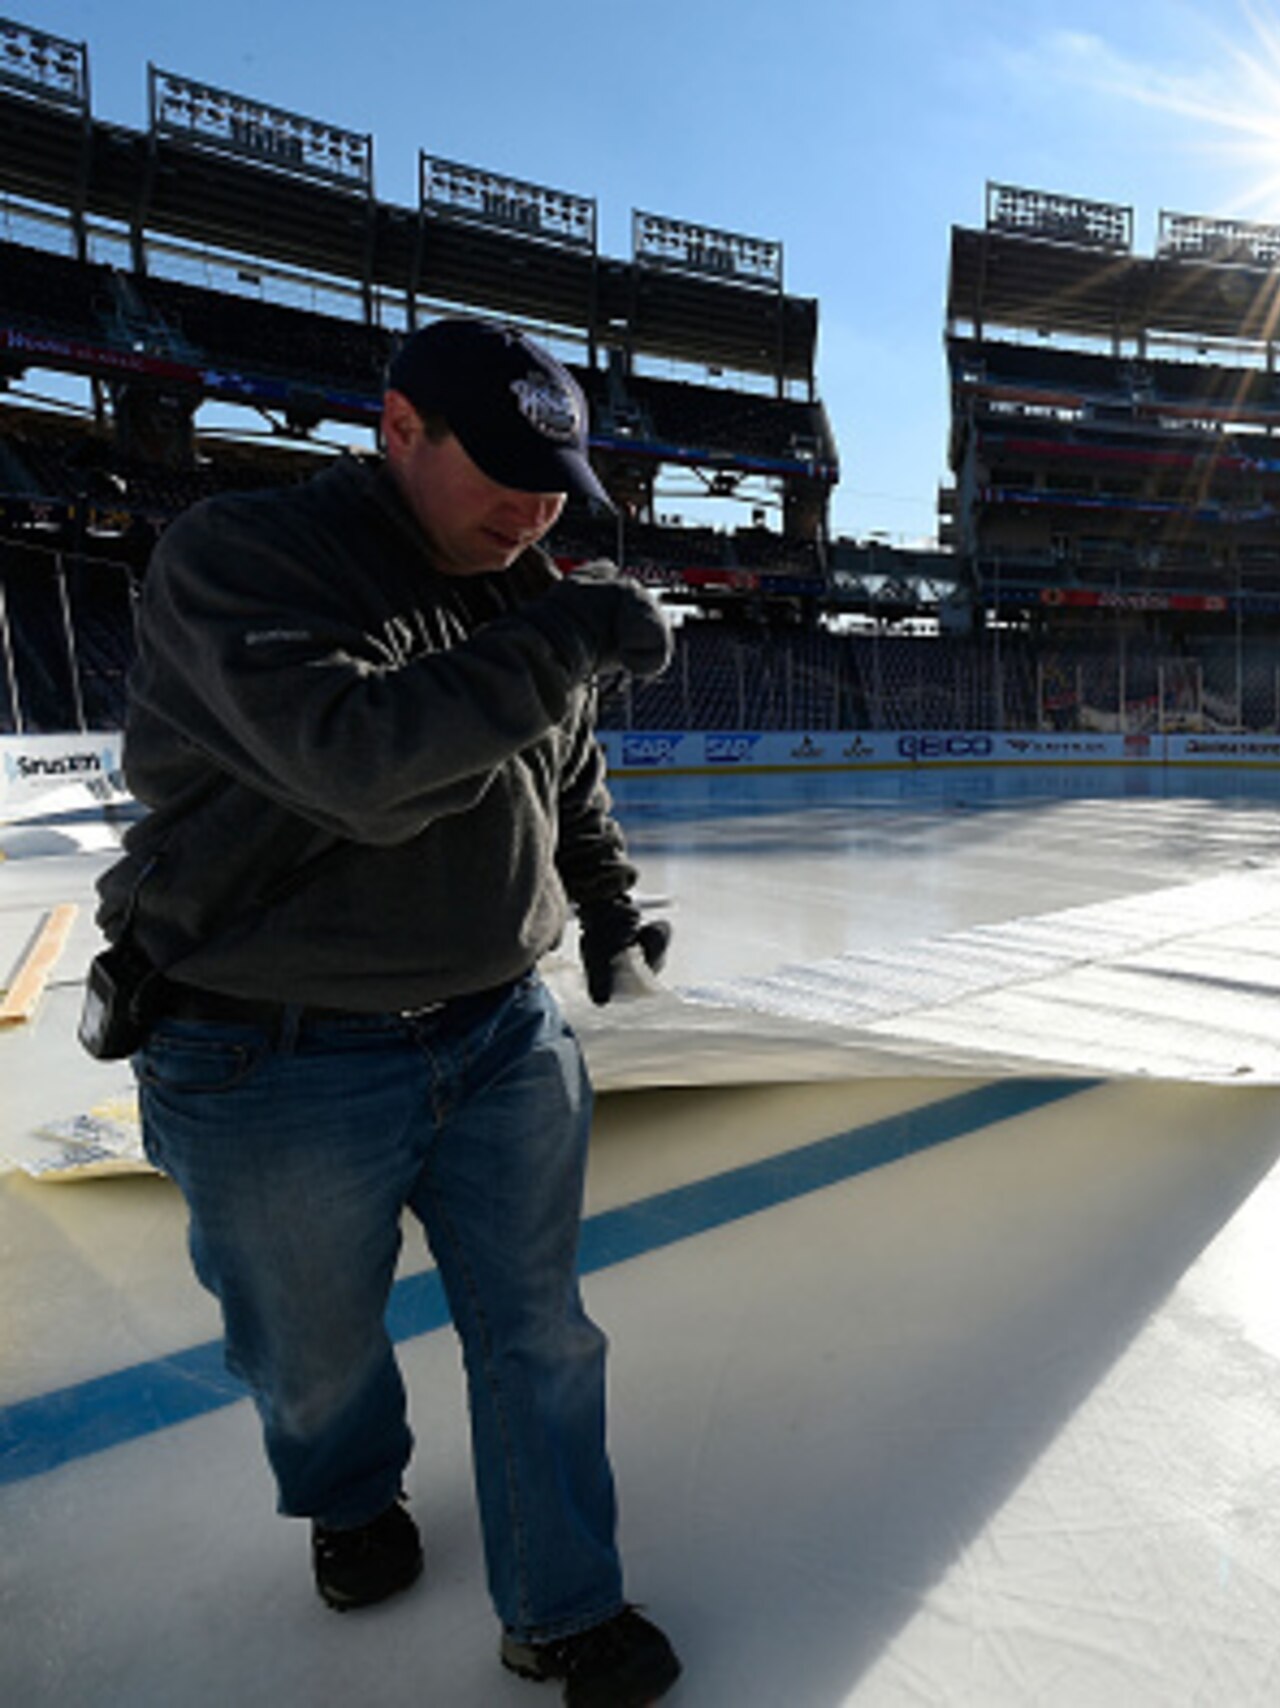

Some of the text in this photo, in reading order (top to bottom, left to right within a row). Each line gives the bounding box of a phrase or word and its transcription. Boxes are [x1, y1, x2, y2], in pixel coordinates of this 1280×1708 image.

[626, 738, 672, 761] SAP
[706, 738, 751, 760] SAP
[898, 735, 991, 757] GEICO
